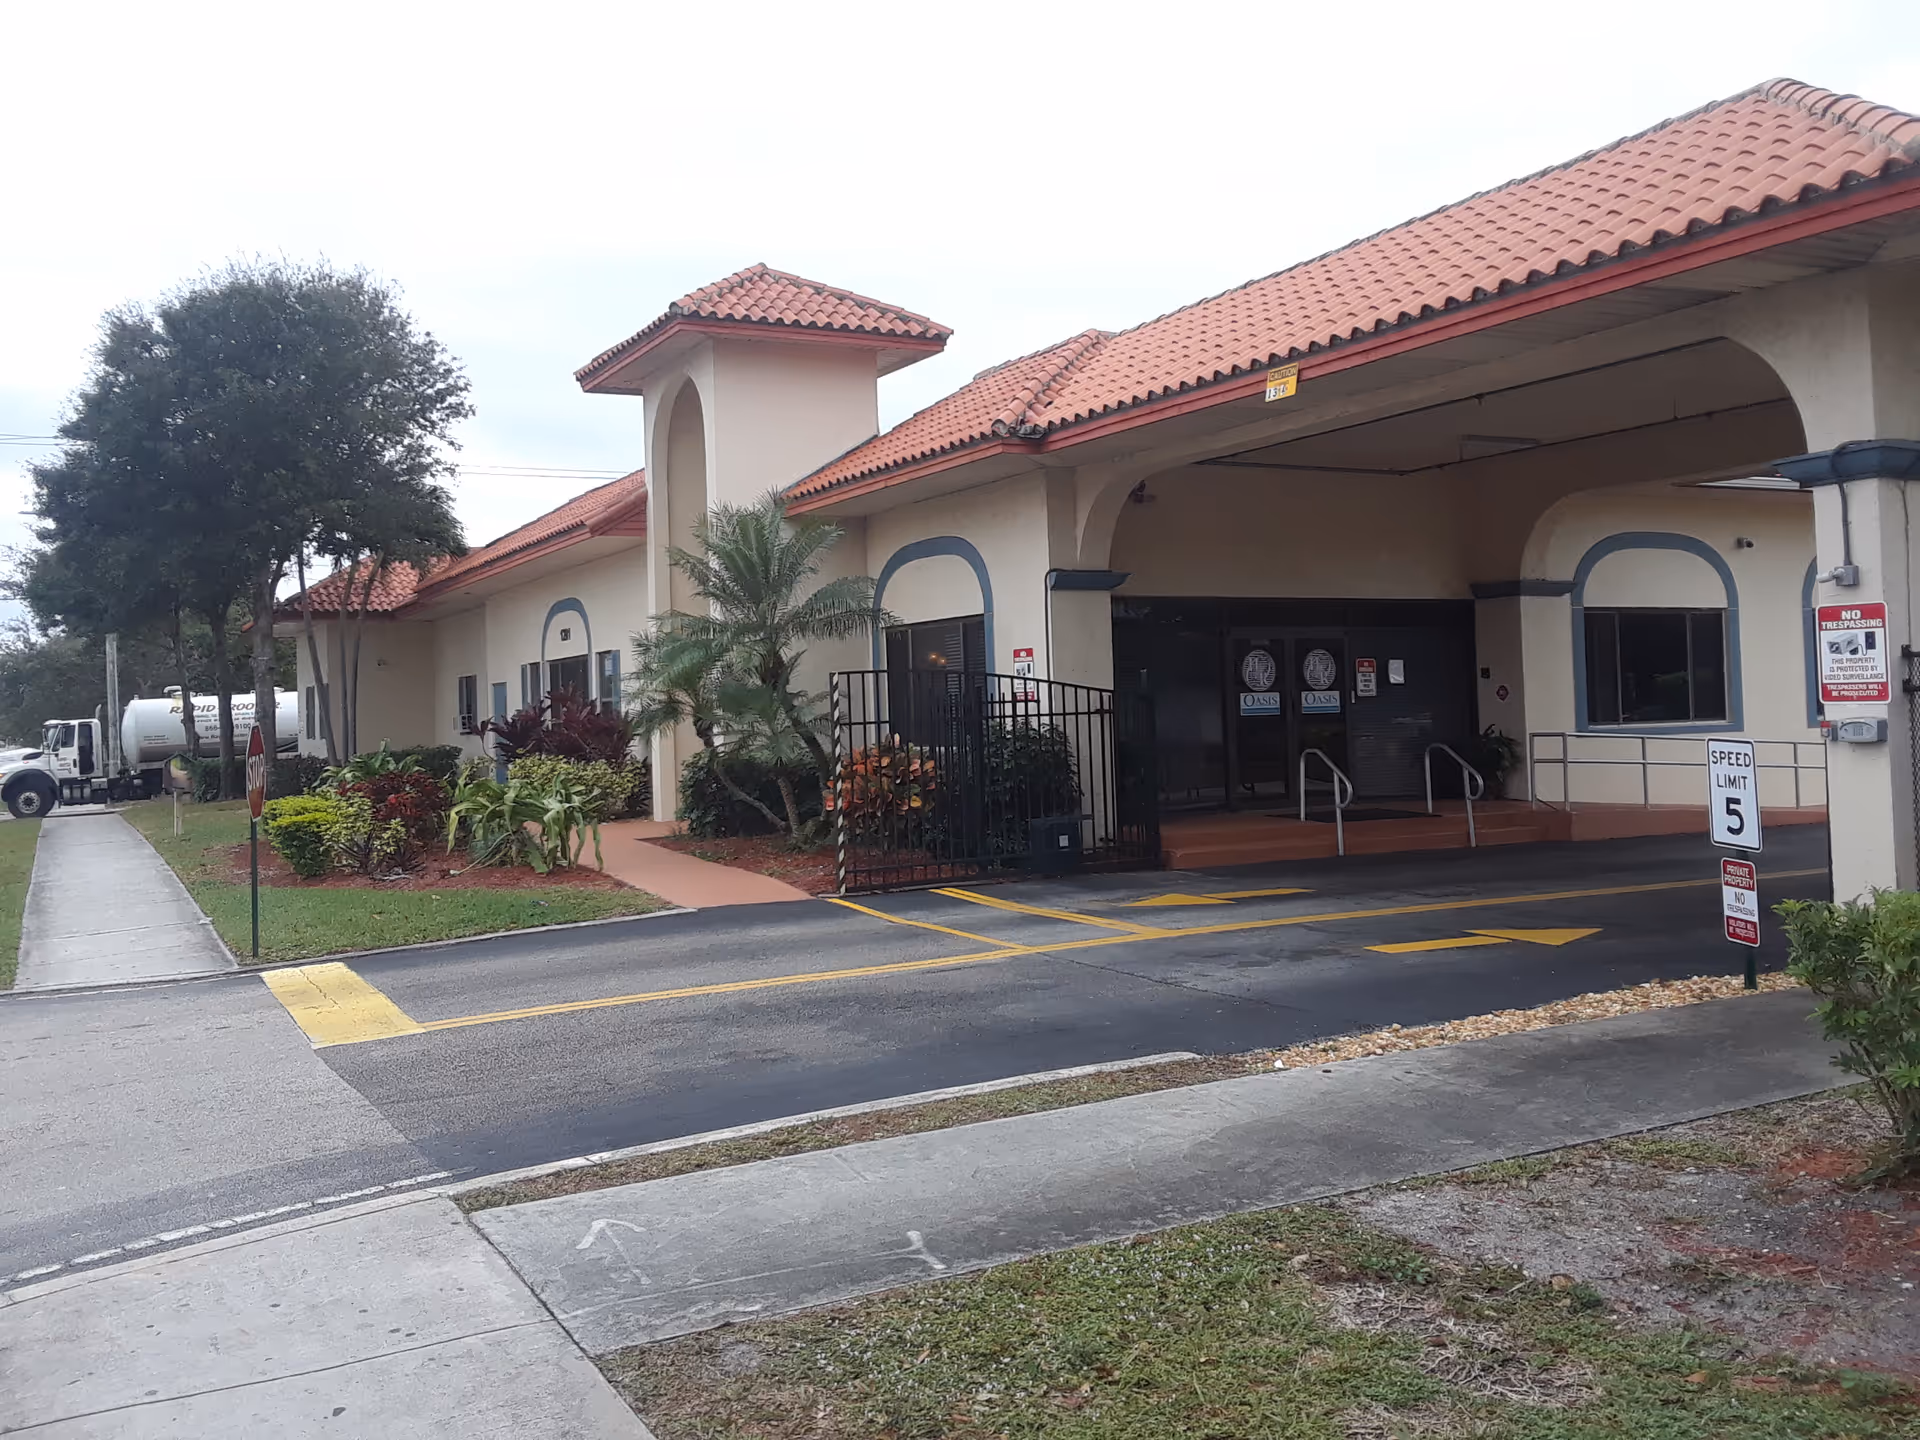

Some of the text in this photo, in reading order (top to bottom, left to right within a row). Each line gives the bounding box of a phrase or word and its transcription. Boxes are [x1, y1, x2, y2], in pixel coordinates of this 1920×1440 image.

[1270, 366, 1296, 380] CAUTION
[1841, 610, 1861, 620] NO
[1821, 619, 1883, 630] TRESPASSING
[1243, 694, 1278, 707] OASIS
[1304, 692, 1338, 705] OASIS
[1711, 750, 1752, 767] SPEED
[248, 753, 264, 791] STOP
[1716, 773, 1748, 790] LIMIT
[1725, 796, 1745, 836] 5
[1726, 864, 1750, 878] PRIVATE
[1724, 874, 1753, 888] PROPERTY
[1734, 891, 1745, 905] NO
